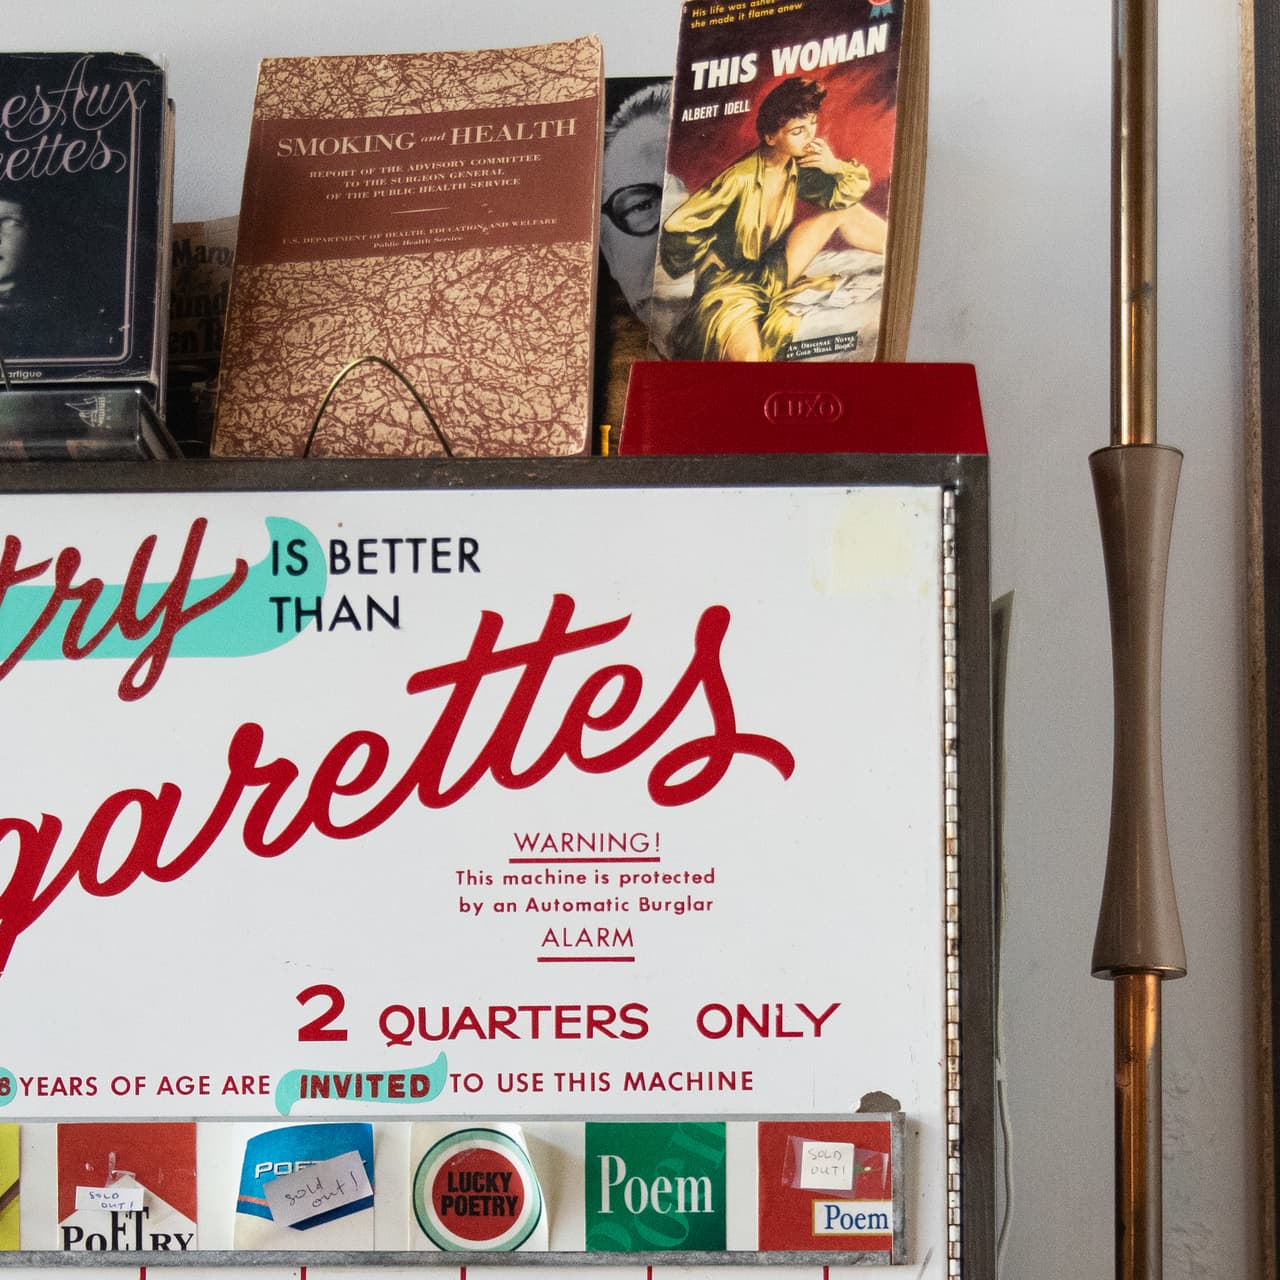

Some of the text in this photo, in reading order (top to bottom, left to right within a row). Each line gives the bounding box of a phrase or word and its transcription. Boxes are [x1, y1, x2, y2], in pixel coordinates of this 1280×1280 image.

[691, 2, 802, 29] she made it flame anew
[692, 2, 747, 18] His life was
[691, 23, 888, 91] THIS WOMAN
[48, 55, 150, 130] Aux
[681, 99, 751, 122] ALBERT IDELL
[277, 118, 577, 158] SMOKING and HEALTH
[310, 154, 541, 178] REPORT OF THE ADVISORY COMMITTEE
[326, 178, 521, 201] OF THE PUBLIC HEALTH SERVICE
[344, 168, 505, 189] TO THE SURGEON GENERAL
[272, 539, 309, 577] IS
[329, 537, 481, 575] BETTER
[270, 595, 402, 633] THAN
[514, 832, 660, 853] WARNING!
[456, 867, 715, 888] This machine is protected
[460, 895, 713, 916] by an Automatic Burglar
[541, 928, 633, 947] ALARM
[296, 984, 841, 1047] 2 QUARTERS ONLY
[19, 1076, 97, 1096] YEARS
[111, 1076, 146, 1096] OF
[157, 1076, 210, 1095] AGE
[222, 1075, 270, 1095] ARE
[300, 1074, 430, 1100] INVITED
[450, 1073, 483, 1093] TO
[498, 1073, 543, 1093] USE
[554, 1072, 610, 1092] THIS
[624, 1071, 752, 1091] MACHINE
[807, 1148, 842, 1161] SOLD
[447, 1171, 512, 1194] LUCKY
[810, 1166, 846, 1178] OUT!
[88, 1191, 120, 1201] SOLD
[284, 1176, 324, 1207] sold
[312, 1171, 358, 1209] out!
[597, 1155, 715, 1214] Poem
[440, 1195, 519, 1217] POETRY
[824, 1205, 888, 1230] Poem
